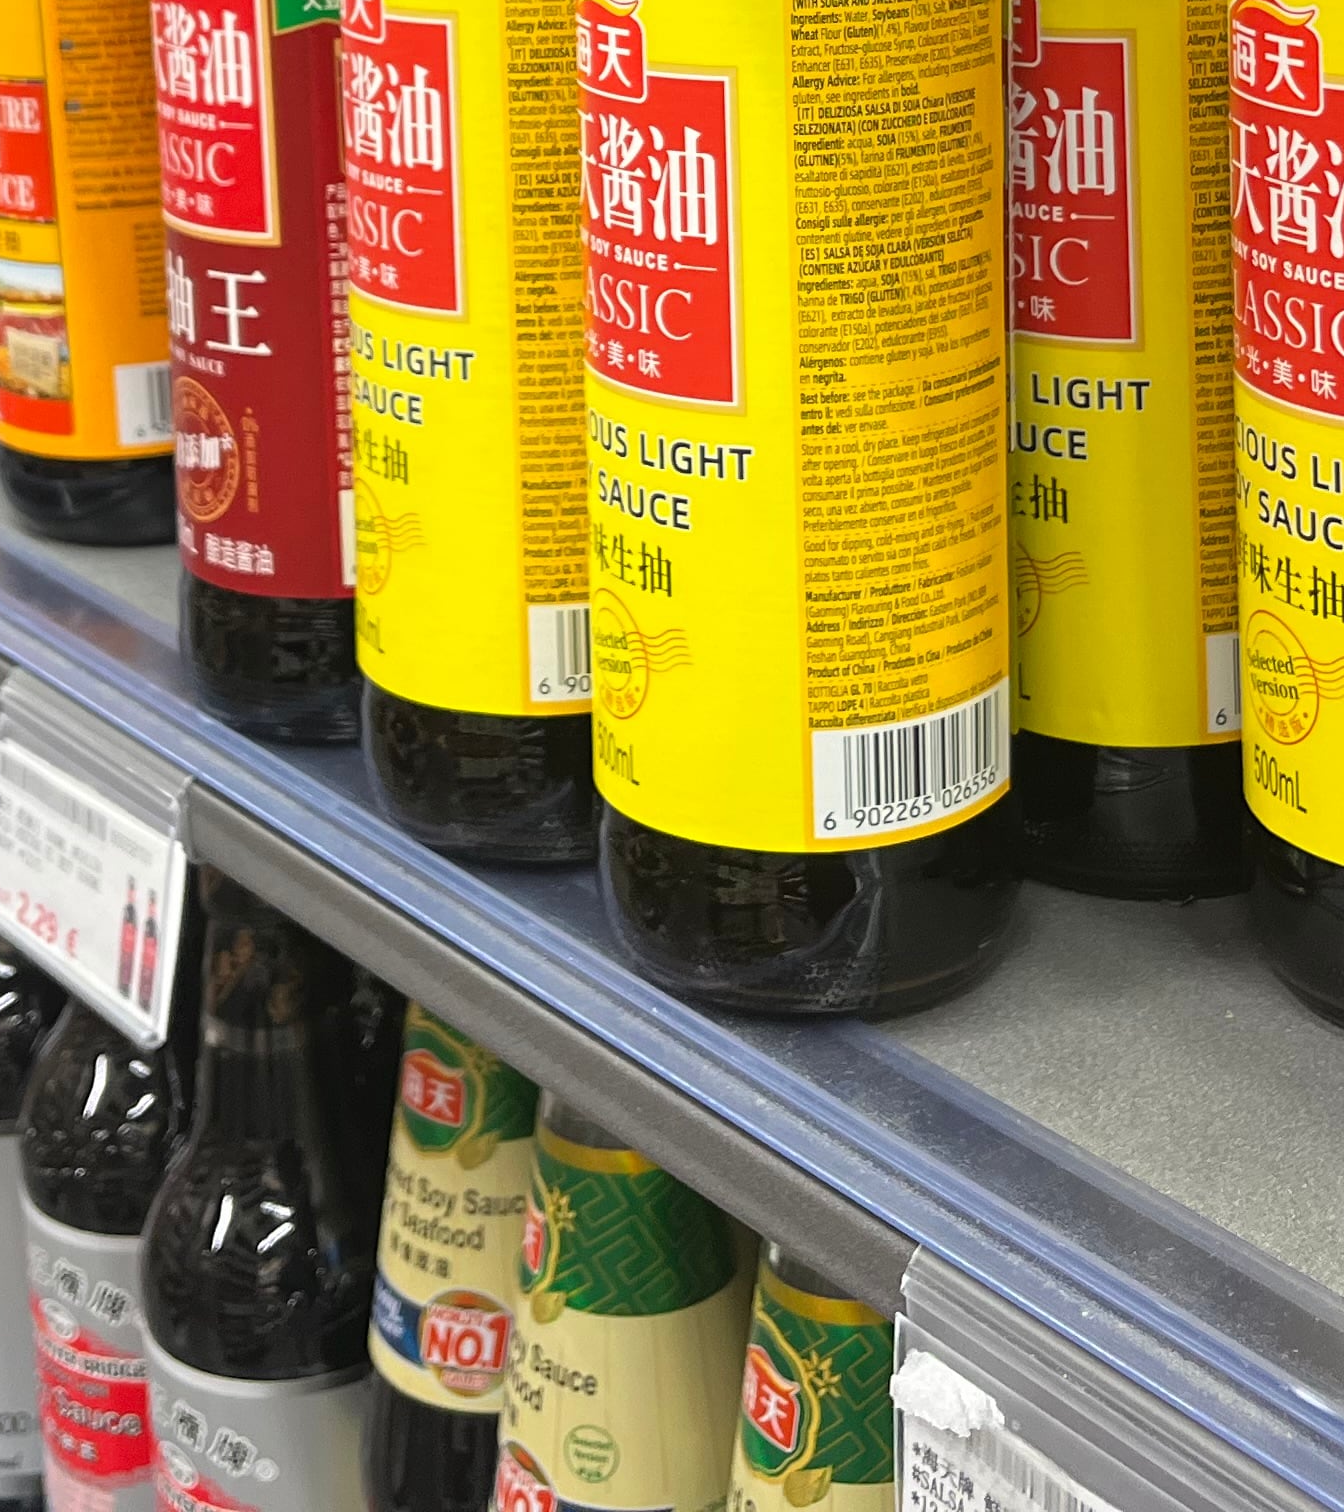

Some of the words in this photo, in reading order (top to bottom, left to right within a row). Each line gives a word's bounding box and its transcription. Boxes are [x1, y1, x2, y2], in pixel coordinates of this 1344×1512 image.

[790, 11, 843, 31] Ingredients:
[872, 7, 910, 26] Soybeans
[1232, 23, 1306, 101] 海天
[792, 74, 825, 93] Allergy
[827, 73, 861, 90] Advice:
[177, 108, 217, 131] SAUCE
[793, 118, 857, 136] SELEZIONATA)
[858, 117, 880, 134] (CON
[881, 113, 923, 130] ZUCCHERO
[362, 175, 404, 197] SAUCE
[614, 248, 669, 273] SAUCE
[1251, 247, 1279, 275] SOY
[382, 340, 475, 382] LIGHT
[1031, 372, 1151, 412] LIGHT
[639, 431, 753, 482] LIGHT
[597, 469, 692, 531] SAUCE
[539, 678, 551, 695] 6
[1253, 741, 1309, 816] 500mL
[822, 810, 837, 831] 6
[853, 794, 933, 829] 902265
[941, 763, 997, 809] 026556
